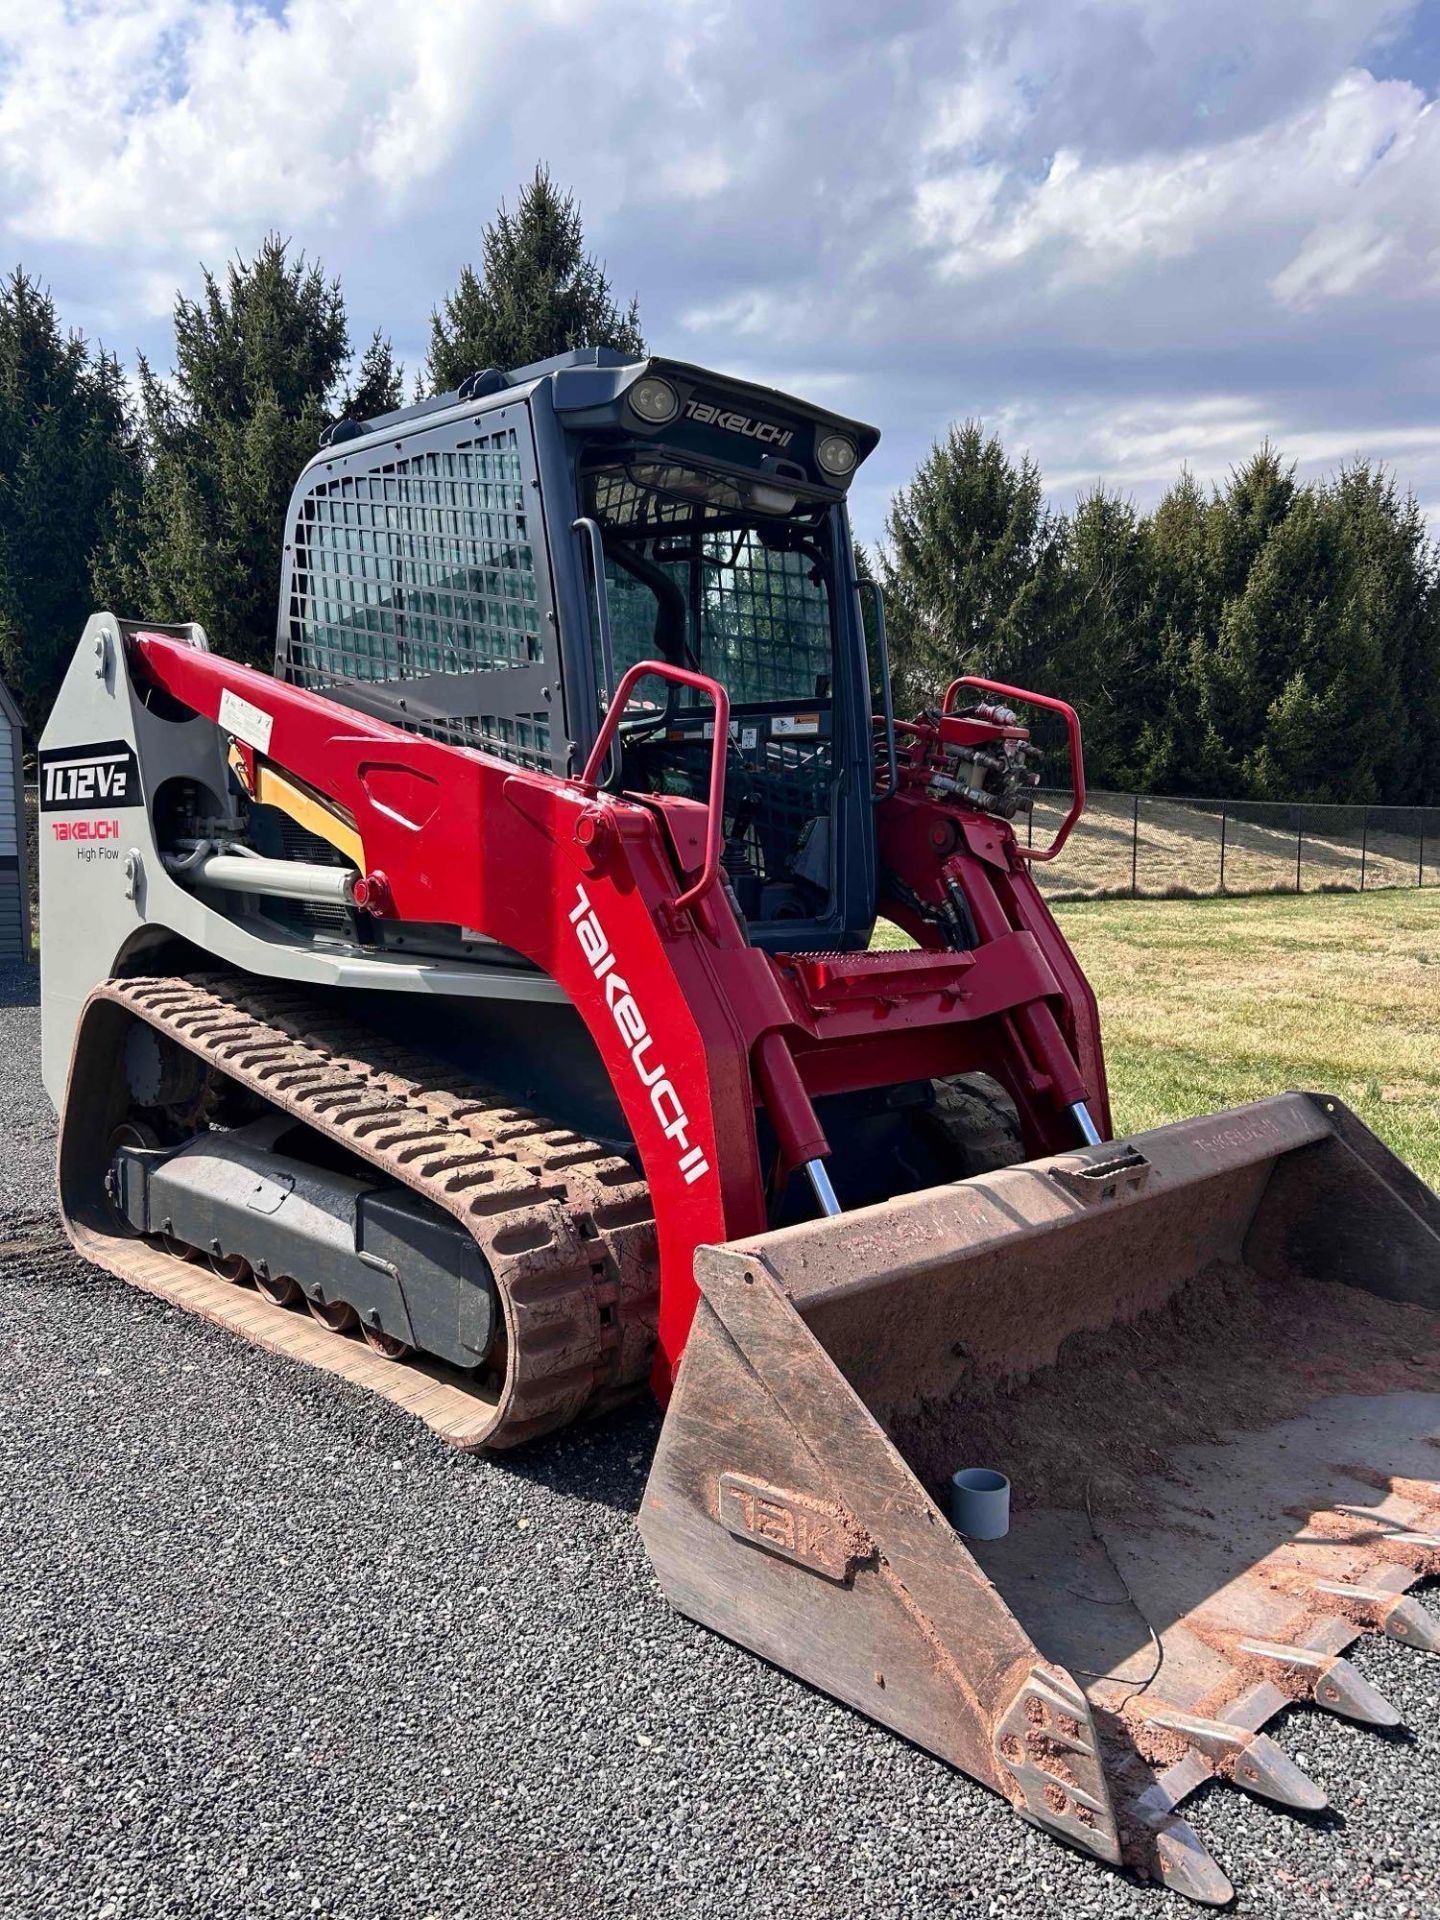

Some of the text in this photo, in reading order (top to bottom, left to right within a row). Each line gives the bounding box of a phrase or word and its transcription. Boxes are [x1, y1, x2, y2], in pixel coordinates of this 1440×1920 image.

[686, 400, 794, 448] TAKEUCHI
[43, 753, 130, 802] TL12V2
[52, 820, 119, 841] TAKEUCHI
[77, 847, 119, 862] High Flow
[568, 883, 710, 1185] TAKEUCHI
